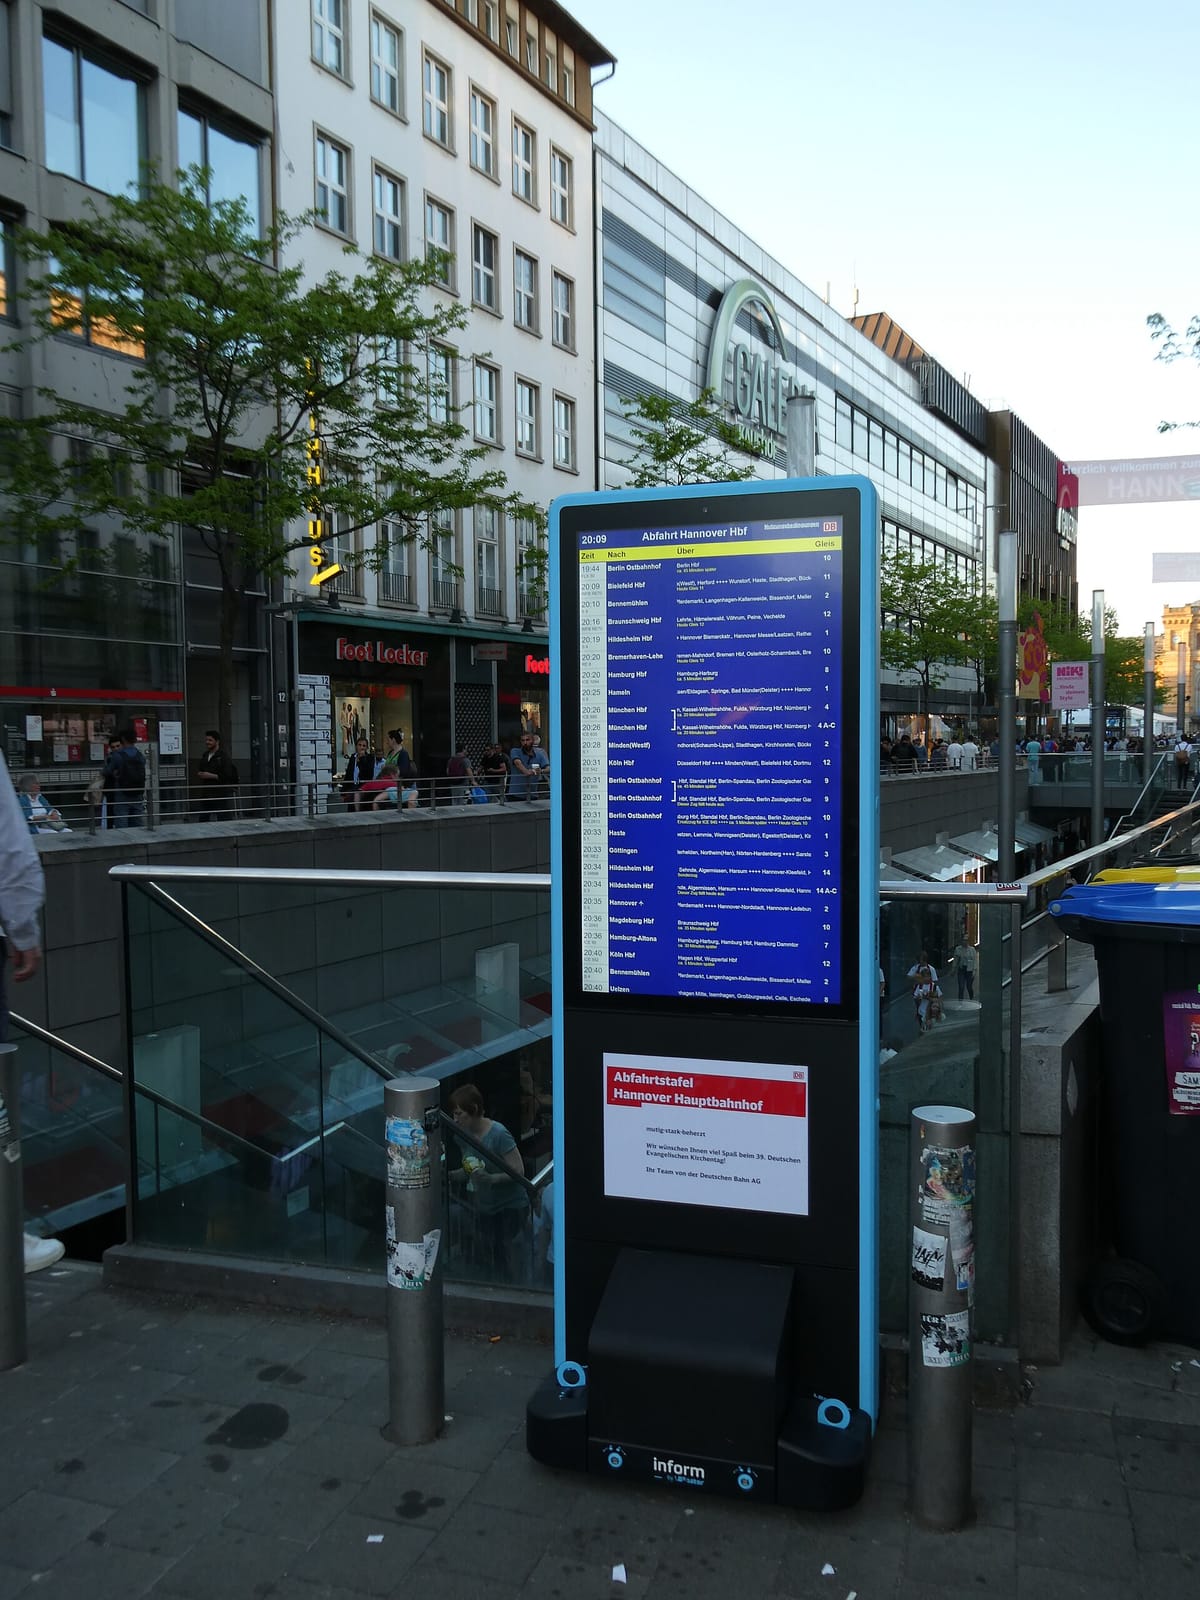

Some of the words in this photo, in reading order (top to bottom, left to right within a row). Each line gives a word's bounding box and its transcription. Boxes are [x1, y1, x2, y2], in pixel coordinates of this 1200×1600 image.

[1062, 464, 1106, 476] Herzlich
[1110, 461, 1177, 473] willkommen
[824, 522, 836, 532] DB
[581, 534, 607, 545] 20:09
[642, 531, 678, 542] Abfahrt
[680, 529, 727, 540] Hannover
[729, 526, 748, 537] Hbf
[676, 546, 695, 555] Über
[626, 563, 662, 571] Ostbahnhof
[336, 638, 374, 662] Foot
[376, 641, 428, 666] Locker
[525, 654, 550, 674] Foot
[278, 691, 286, 702] 12
[322, 731, 330, 739] 12
[609, 916, 642, 925] Magdeburg
[609, 934, 657, 942] Hamburg-Altona
[614, 1071, 694, 1088] Abfahrtstafel
[613, 1087, 672, 1103] Hannover
[674, 1093, 764, 1112] Hauptbahnhof
[646, 1151, 689, 1161] Evangelischen
[690, 1154, 726, 1164] Kirchentag!
[658, 1143, 689, 1152] wünschen
[722, 1150, 737, 1158] Spaß
[768, 1155, 801, 1164] Deutschen
[700, 1173, 732, 1182] Deutschen
[653, 1456, 705, 1479] inform
